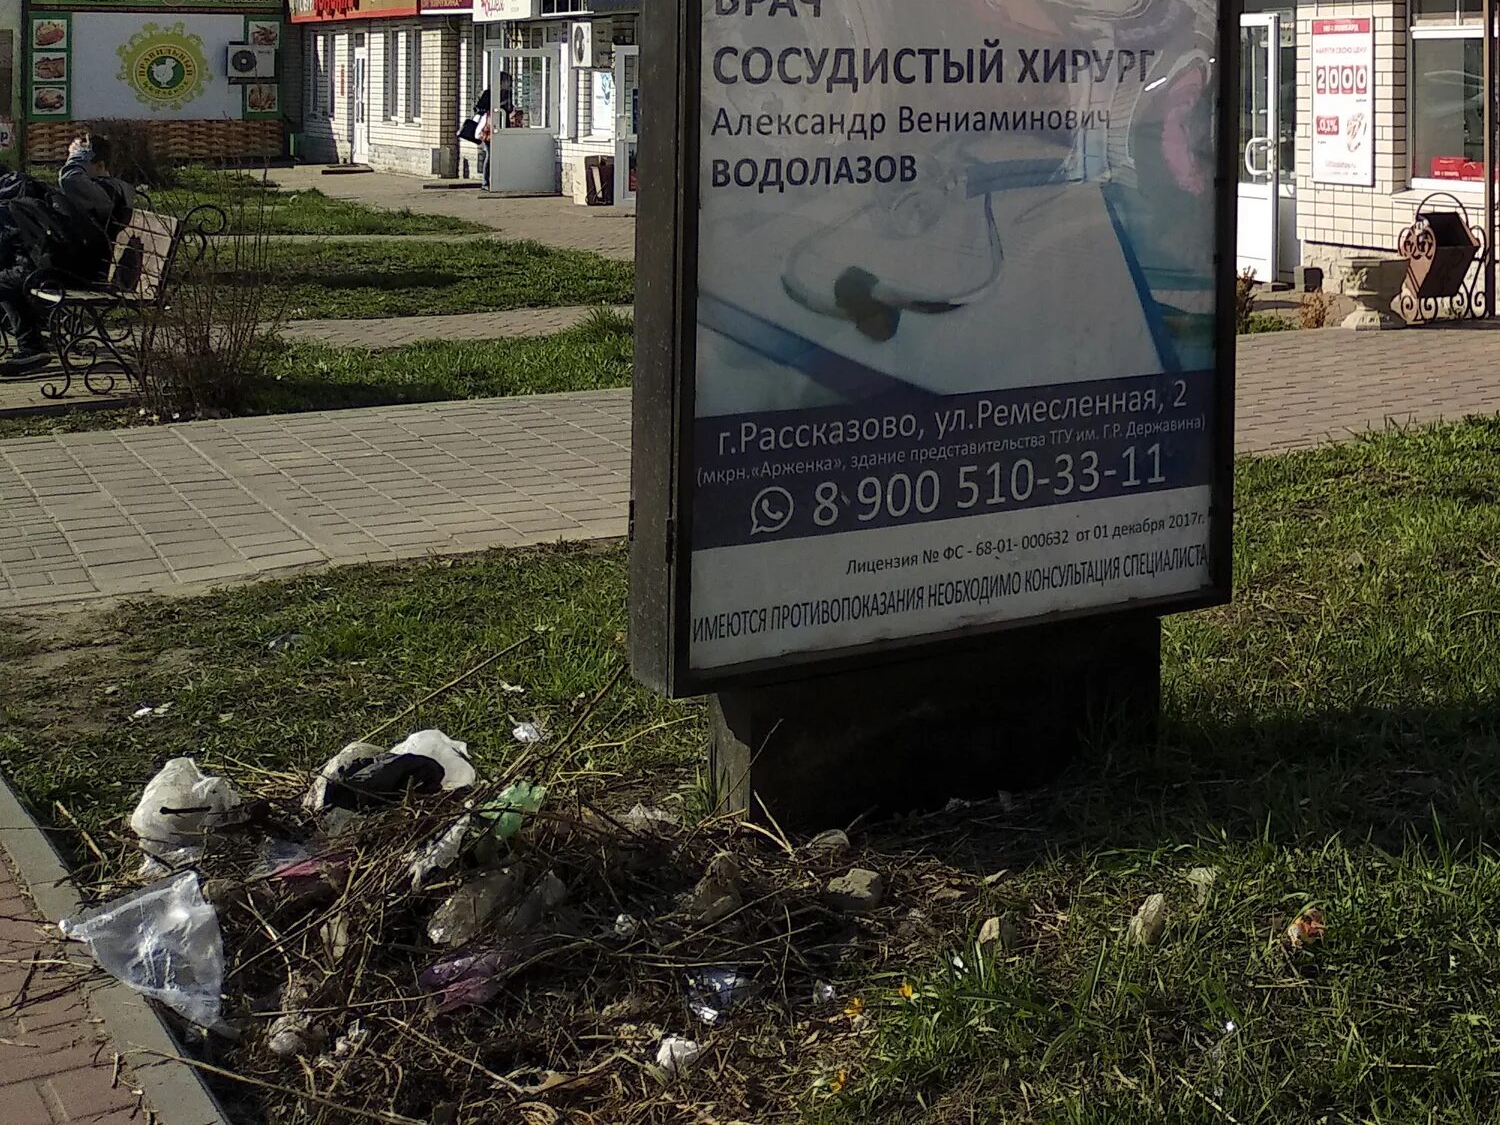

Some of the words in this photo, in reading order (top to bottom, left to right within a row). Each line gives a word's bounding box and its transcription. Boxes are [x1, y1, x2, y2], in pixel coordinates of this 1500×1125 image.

[712, 38, 1004, 94] СОСУДИСТЫЙ
[1017, 48, 1155, 84] ХИРУРГ
[710, 106, 886, 141] Александр
[898, 105, 1111, 133] Вениаминович
[711, 155, 918, 192] ВОДОЛАЗОВ
[697, 458, 847, 488] (мкрн.«Арженка»,
[851, 451, 906, 470] здание
[910, 434, 1046, 464] представительства
[1050, 429, 1073, 446] ТГУ
[1075, 428, 1099, 443] им.
[1126, 413, 1205, 438] Державина)
[717, 413, 924, 456] г.Рассказово,
[935, 389, 1165, 440] ул.Ремесленная,
[1173, 379, 1187, 408] 2
[813, 481, 839, 526] 8
[857, 469, 941, 522] 900
[956, 443, 1166, 509] 510-33-11
[846, 554, 919, 575] Лицензия
[923, 549, 940, 564] №
[943, 544, 964, 561] ФС
[1022, 530, 1069, 550] 000632
[1077, 529, 1091, 543] от
[1093, 525, 1109, 540] 01
[1112, 517, 1165, 541] декабря
[1168, 512, 1205, 530] 2017г.
[693, 608, 768, 644] ИМЕЮТСЯ
[771, 586, 925, 631] ПРОТИВОПОКАЗАНИЯ
[928, 572, 1021, 607] НЕОБХОДИМО
[1025, 556, 1120, 594] КОНСУЛЬТАЦИЯ
[1123, 543, 1209, 578] СПЕЦИАЛИСТА
